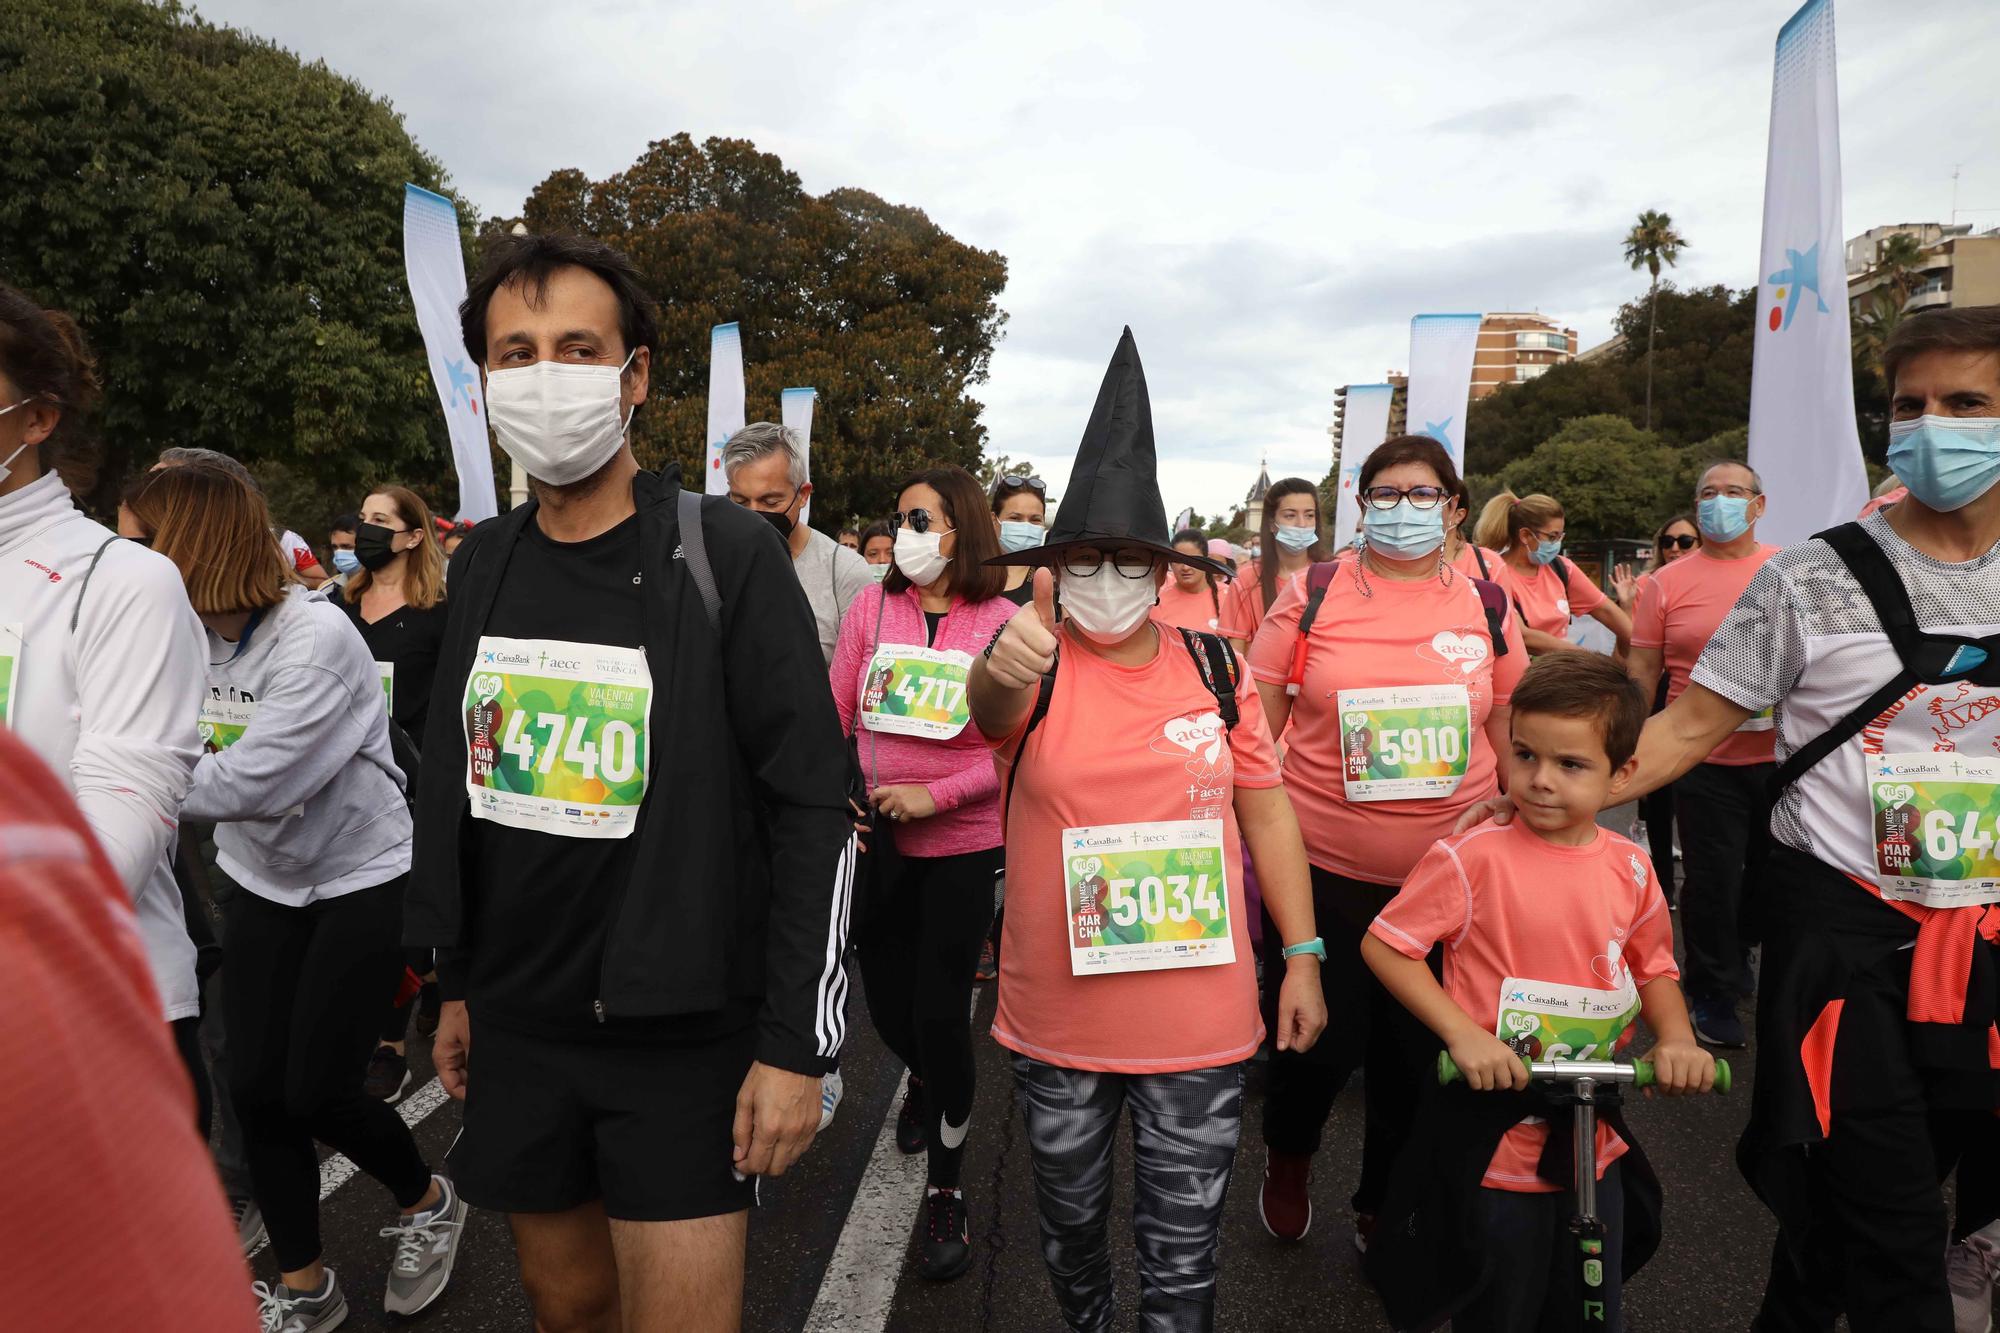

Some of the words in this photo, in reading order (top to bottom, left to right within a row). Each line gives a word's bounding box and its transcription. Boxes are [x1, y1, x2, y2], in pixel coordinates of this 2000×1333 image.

[1441, 644, 1484, 657] aecc
[496, 651, 530, 665] CaixaBank
[550, 658, 581, 670] aecc
[478, 677, 489, 689] YO
[867, 691, 883, 700] MAR
[894, 674, 966, 713] 4717
[866, 698, 881, 707] CHA
[474, 704, 482, 724] AECC
[474, 724, 484, 746] RUN
[502, 709, 636, 782] 4740
[1379, 725, 1461, 766] 5910
[474, 746, 493, 762] MAR
[1349, 756, 1367, 765] MAR
[475, 761, 493, 777] CHA
[1350, 765, 1368, 775] CHA
[1895, 765, 1941, 775] CaixaBank
[1200, 786, 1226, 797] aecc
[1883, 787, 1896, 797] YO
[1885, 809, 1894, 825] AECC
[1143, 833, 1169, 843] aecc
[1886, 824, 1898, 843] RUN
[1924, 810, 2000, 861] 64
[1087, 837, 1123, 847] CaixaBank
[1883, 844, 1911, 857] MAR
[1076, 860, 1087, 871] YO
[1885, 856, 1912, 868] CHA
[1080, 896, 1091, 914] RUN
[1109, 873, 1220, 928] 5034
[1078, 913, 1101, 927] MAR
[1079, 926, 1101, 939] CHA
[1528, 993, 1569, 1007] CaixaBank
[1593, 1002, 1621, 1012] aecc
[1511, 1015, 1523, 1026] YO
